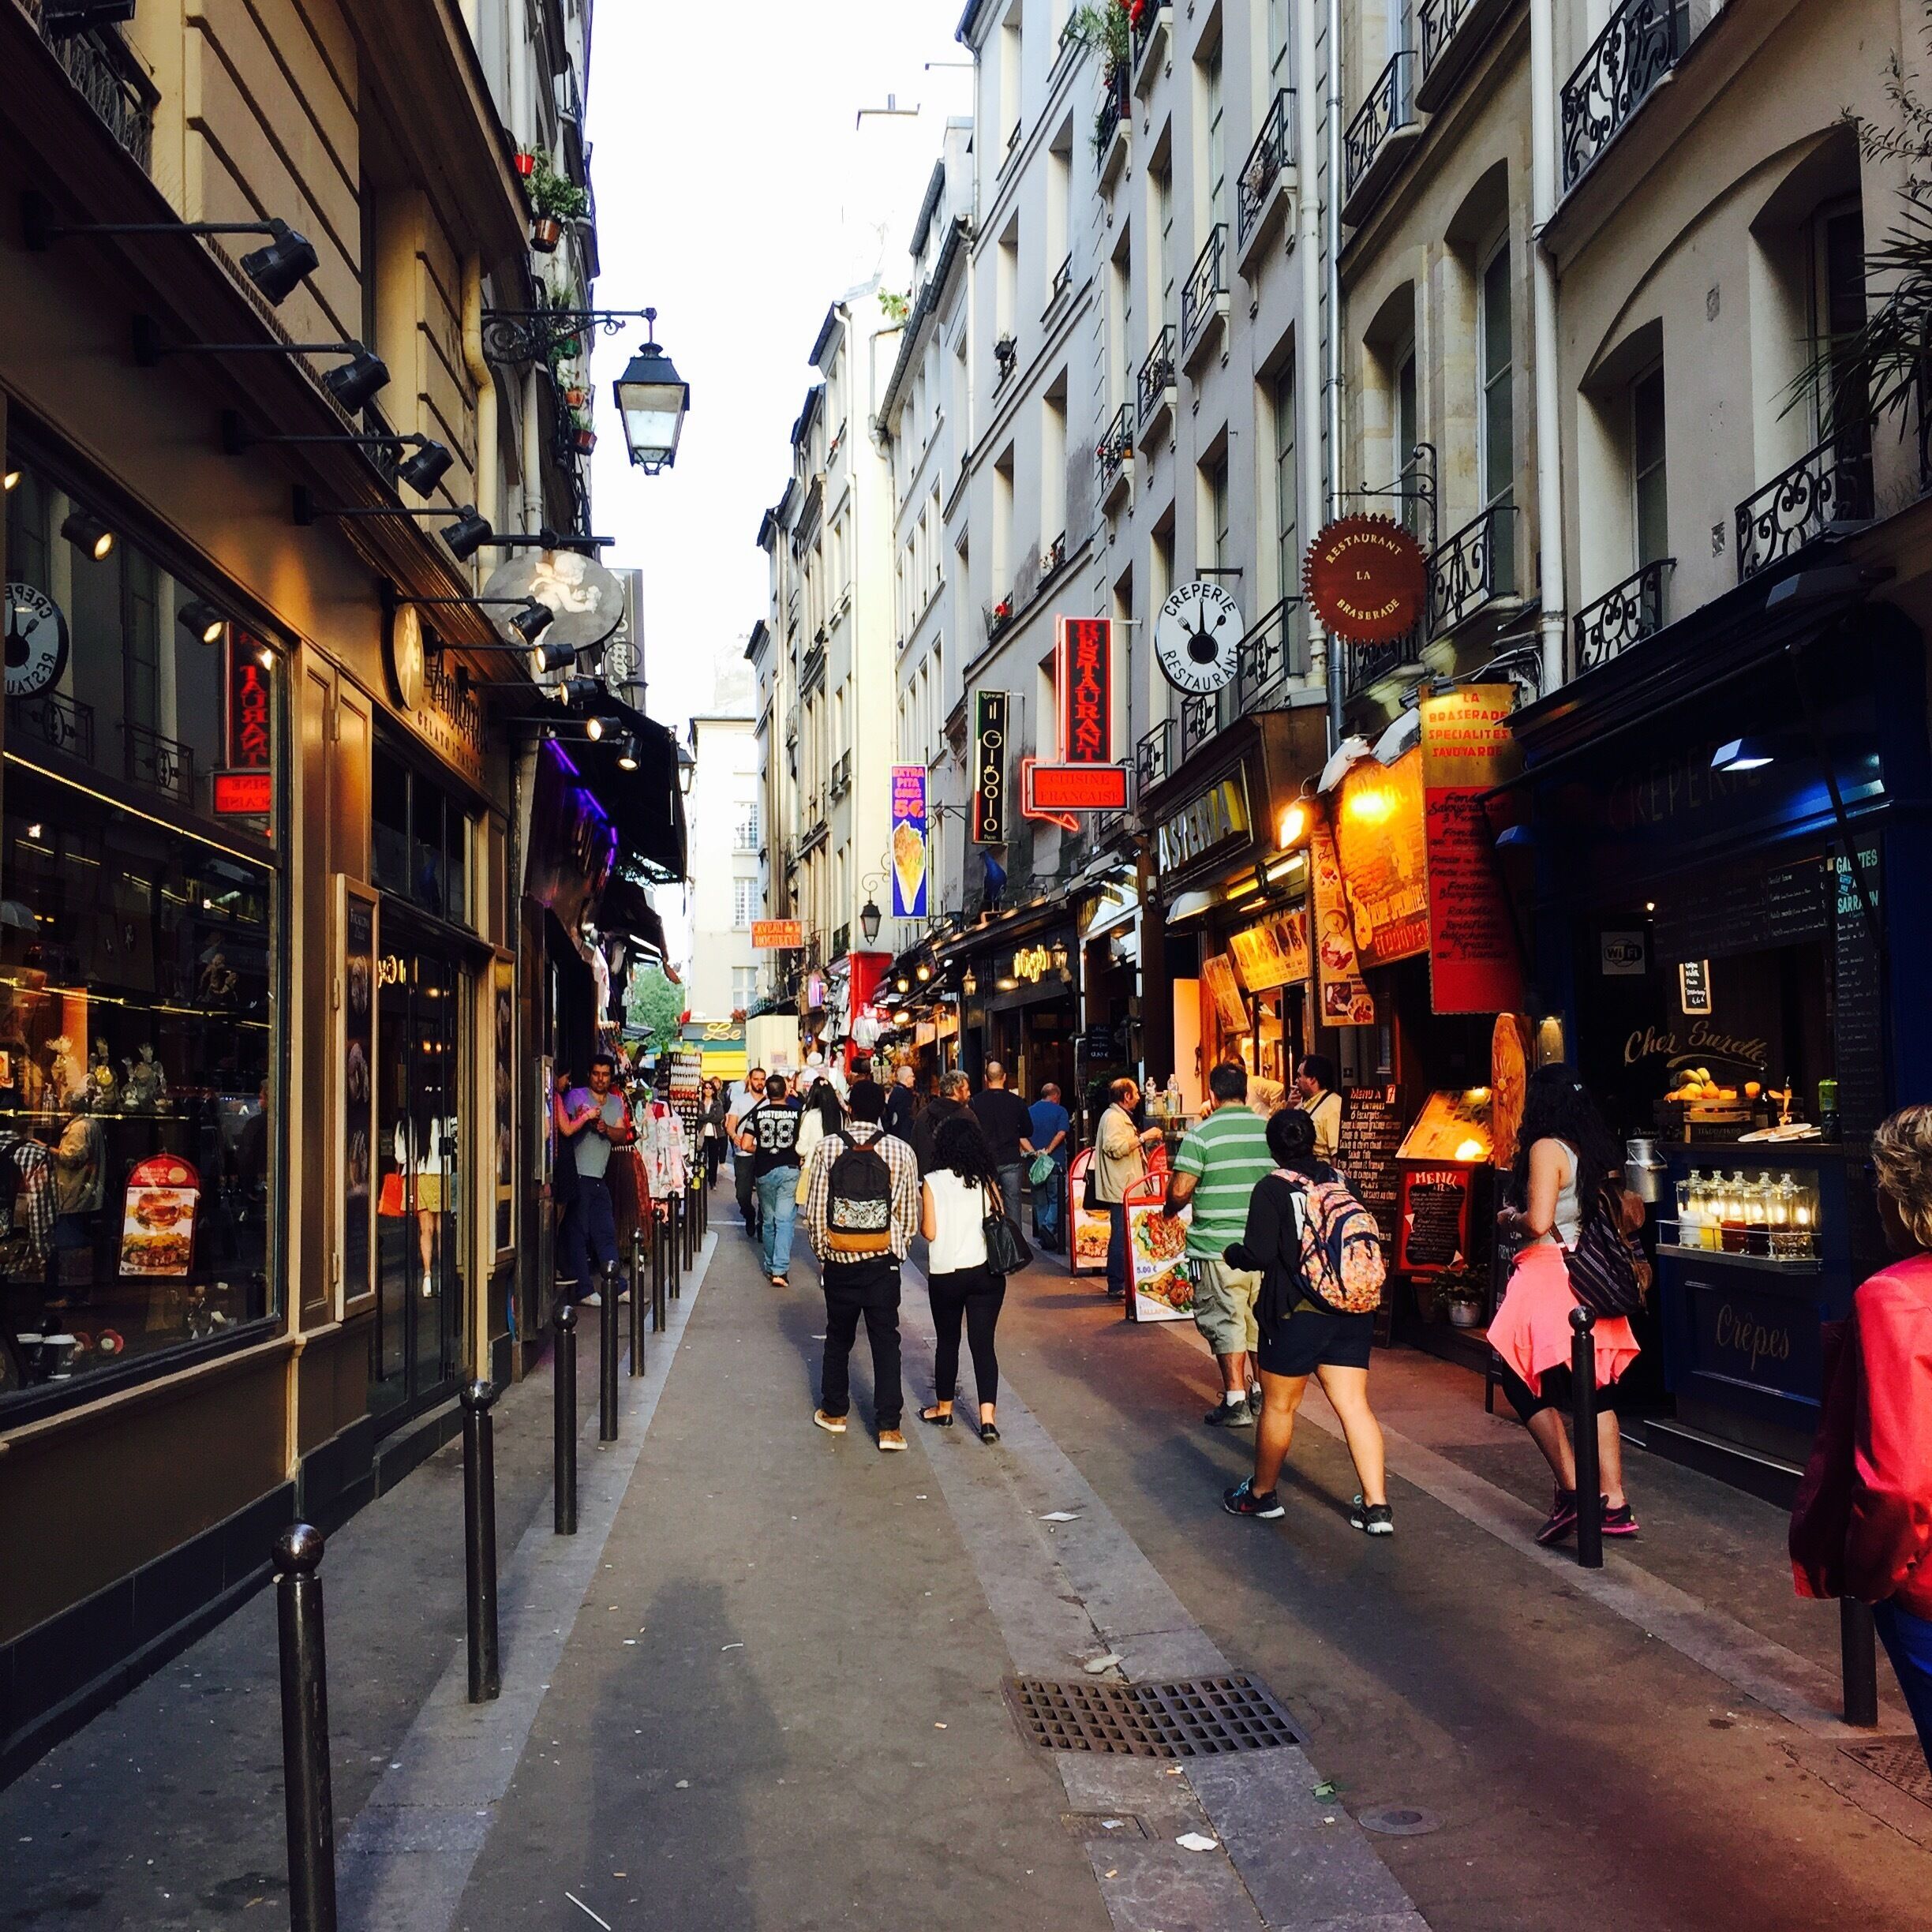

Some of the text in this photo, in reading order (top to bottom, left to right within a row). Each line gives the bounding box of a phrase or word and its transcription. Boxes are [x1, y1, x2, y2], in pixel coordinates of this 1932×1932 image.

[1325, 534, 1402, 564] RESTAURANT
[1356, 570, 1372, 581] LA
[1163, 583, 1236, 618] CREPERIE
[1336, 597, 1400, 621] BRASERADE
[1163, 646, 1238, 693] RESTAURANT
[1076, 621, 1102, 761] RESTAURANT
[1463, 693, 1480, 702] LA
[1429, 710, 1509, 722] BRASERADE
[417, 710, 450, 750] GELATO
[1428, 729, 1509, 739] SPECIALITES
[1432, 746, 1503, 758] SAVOYARDE
[893, 767, 924, 777] EXTRA
[1050, 774, 1110, 784] CUISINE
[897, 777, 919, 788] PITA
[893, 799, 924, 818] 5€
[1837, 849, 1878, 874] GALTES
[1837, 890, 1878, 914] SARRAN
[702, 1022, 742, 1041] Le
[1624, 1020, 1769, 1067] Chez Suzette
[757, 1110, 798, 1119] AMSTERDAM
[759, 1118, 795, 1148] 88
[1415, 1172, 1457, 1189] MENU
[1717, 1303, 1790, 1372] Crêpes
